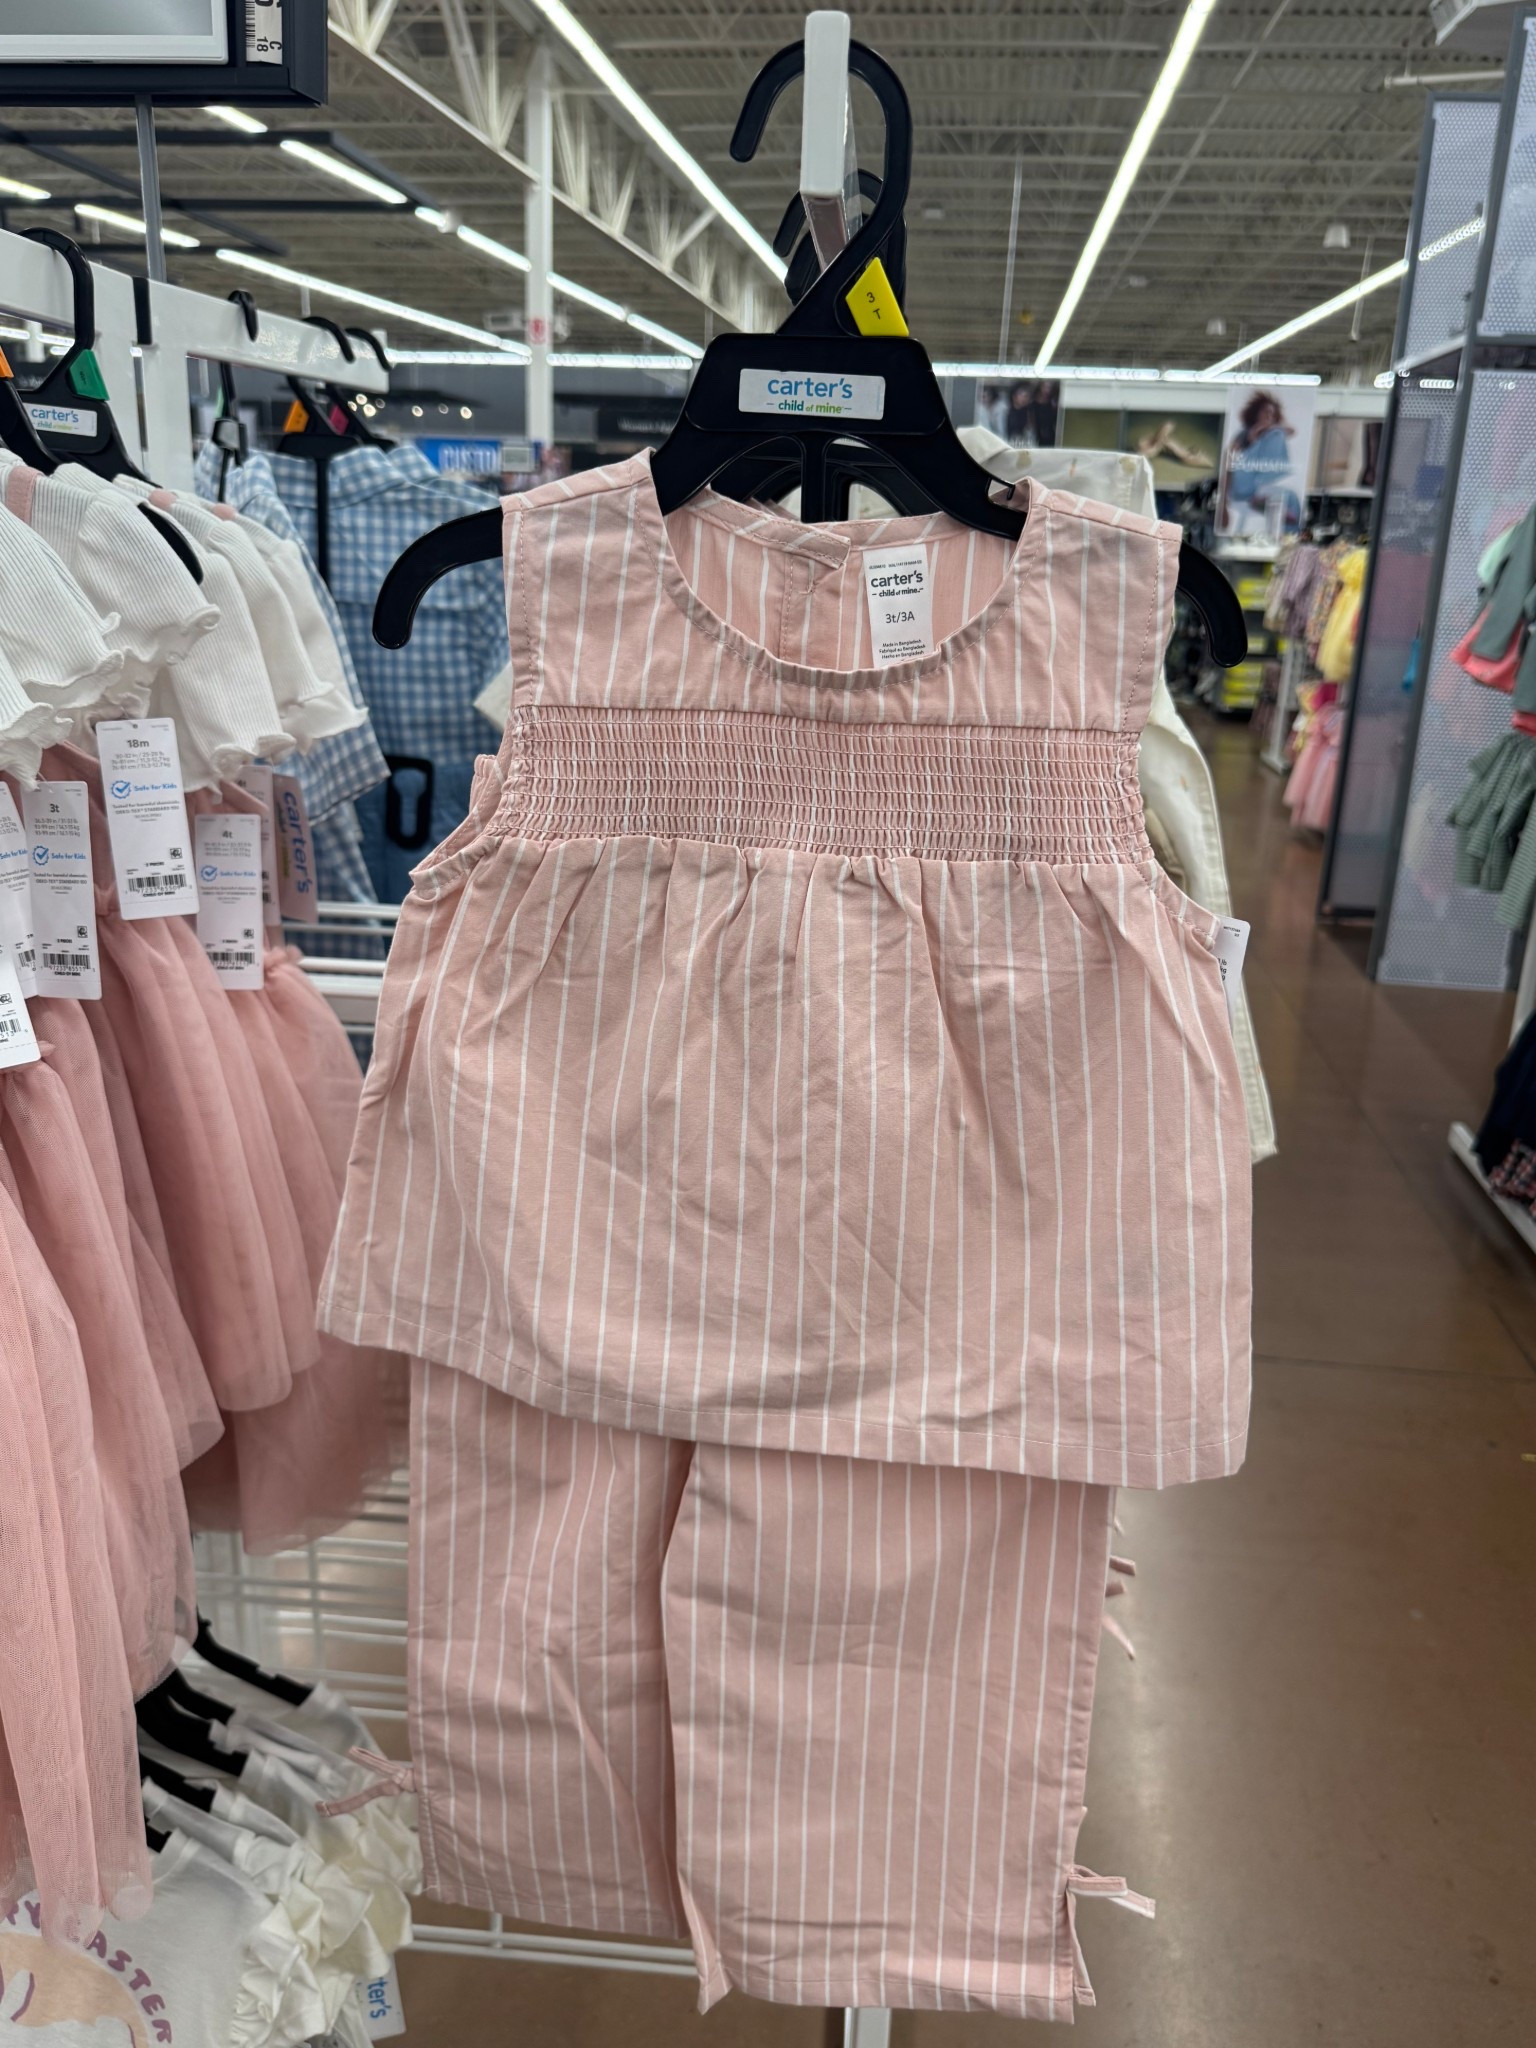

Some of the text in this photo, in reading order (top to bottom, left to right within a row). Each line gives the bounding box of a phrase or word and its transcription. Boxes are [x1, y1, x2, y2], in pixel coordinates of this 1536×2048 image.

[256, 36, 269, 52] 18
[270, 40, 283, 51] C
[866, 291, 876, 304] 3
[872, 308, 882, 321] T
[767, 377, 853, 400] carter's
[778, 399, 805, 412] child
[805, 404, 814, 412] of
[31, 408, 79, 423] carter's
[870, 570, 924, 588] carter's
[878, 588, 896, 598] child
[885, 611, 915, 624] 3t/3A
[899, 638, 922, 647] Bangladesh
[903, 644, 926, 652] Bangladesh
[127, 739, 150, 748] 18m
[134, 784, 149, 792] Safe
[50, 803, 60, 813] 3t
[222, 830, 233, 839] 4t
[284, 791, 313, 894] carter's
[51, 852, 64, 860] Safe
[367, 1976, 392, 2018] ter's
